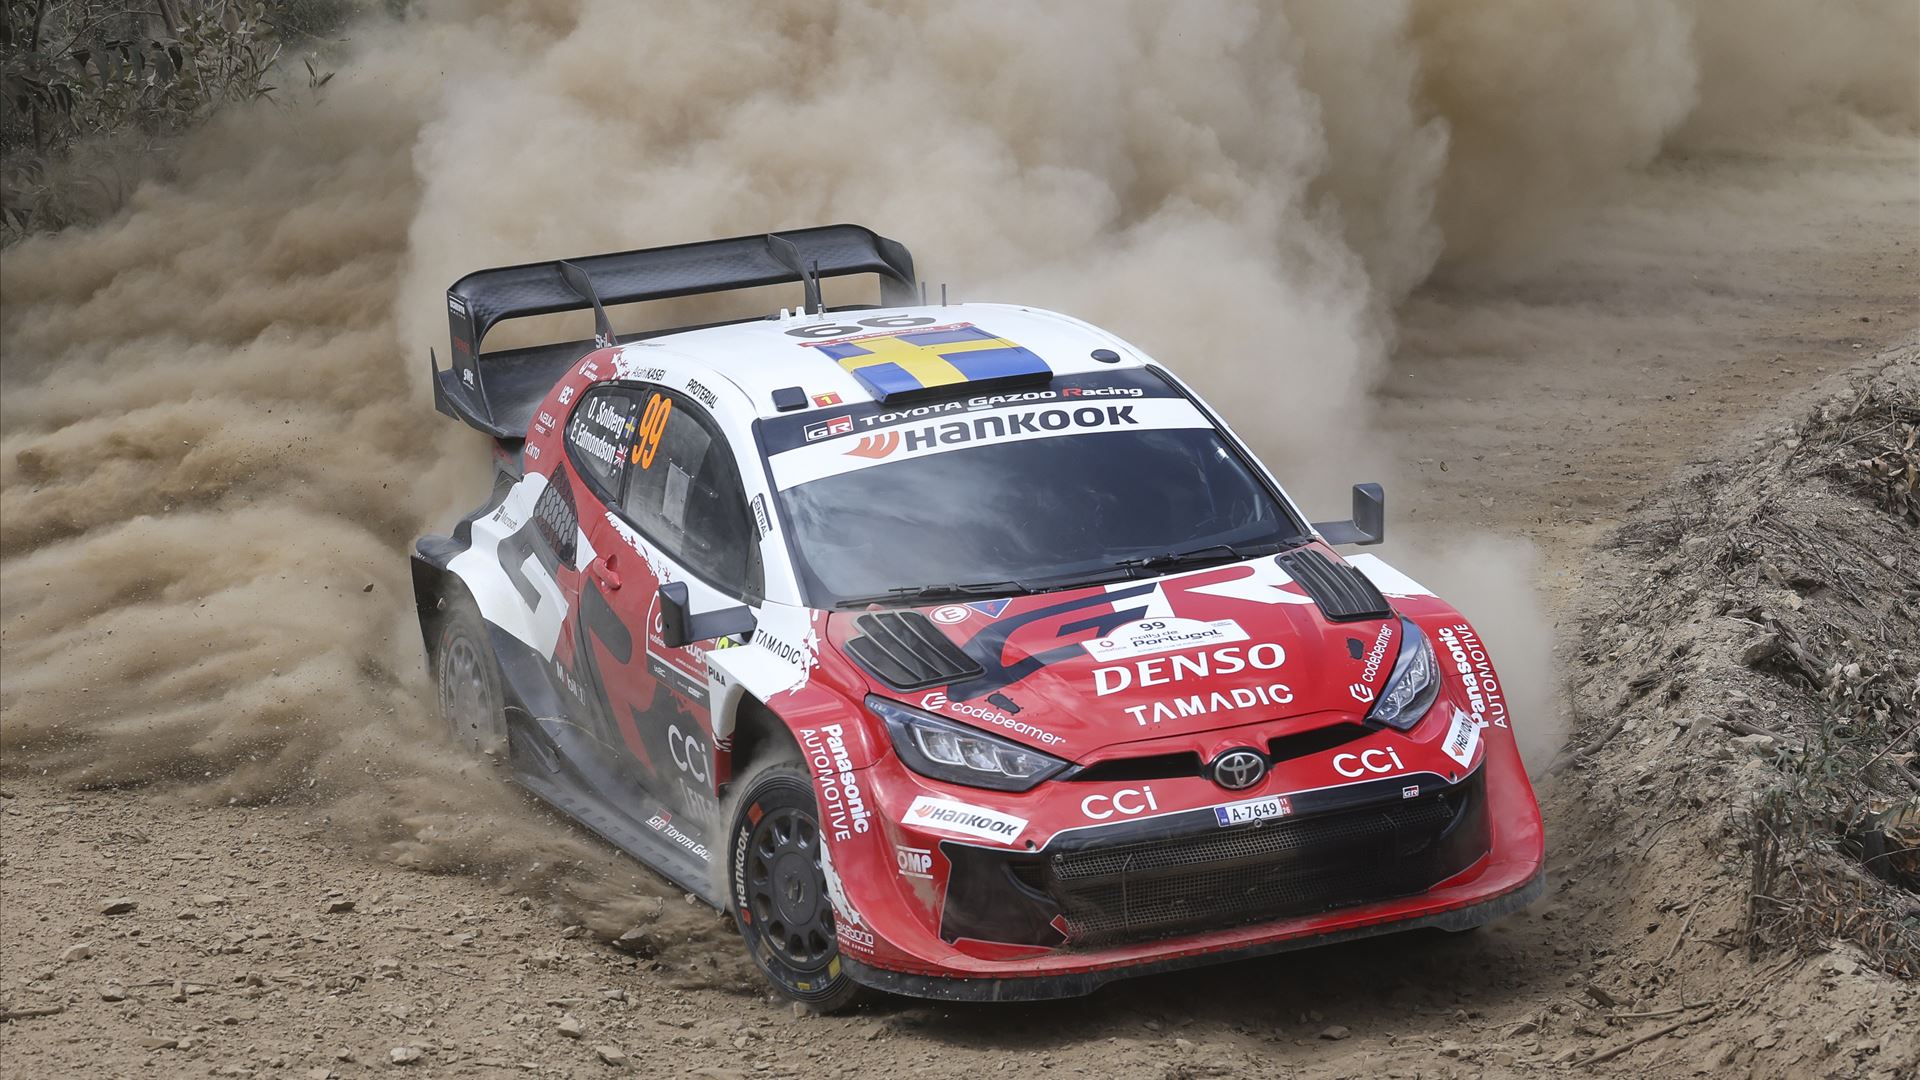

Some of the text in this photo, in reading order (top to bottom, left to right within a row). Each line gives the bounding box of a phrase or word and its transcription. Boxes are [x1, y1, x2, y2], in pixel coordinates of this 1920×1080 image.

[685, 379, 719, 409] PROTERIAL
[807, 384, 1144, 440] GR TOYOTA GAZOO Racing
[587, 397, 627, 439] O. Solberg
[631, 393, 672, 469] 99
[575, 427, 617, 464] Edmondson
[753, 496, 767, 537] CENTRAL
[941, 608, 961, 620] E
[1139, 621, 1166, 632] 99
[1161, 628, 1178, 637] de
[755, 629, 801, 664] TAMADIC
[1132, 629, 1223, 647] Portugal
[1362, 624, 1393, 683] codebeamer
[708, 666, 726, 687] PIAA
[1091, 643, 1286, 697] DENSO
[1438, 627, 1489, 729] Panasonic
[1453, 623, 1507, 729] AUTOMOTIVE
[951, 701, 1061, 747] codebeamer
[1124, 683, 1294, 727] TAMADIC
[800, 728, 851, 842] AUTOMOTIVE
[821, 724, 872, 833] Panasonic
[1232, 802, 1278, 821] A-7649
[663, 824, 694, 849] TOYOTA
[897, 853, 932, 873] OMP
